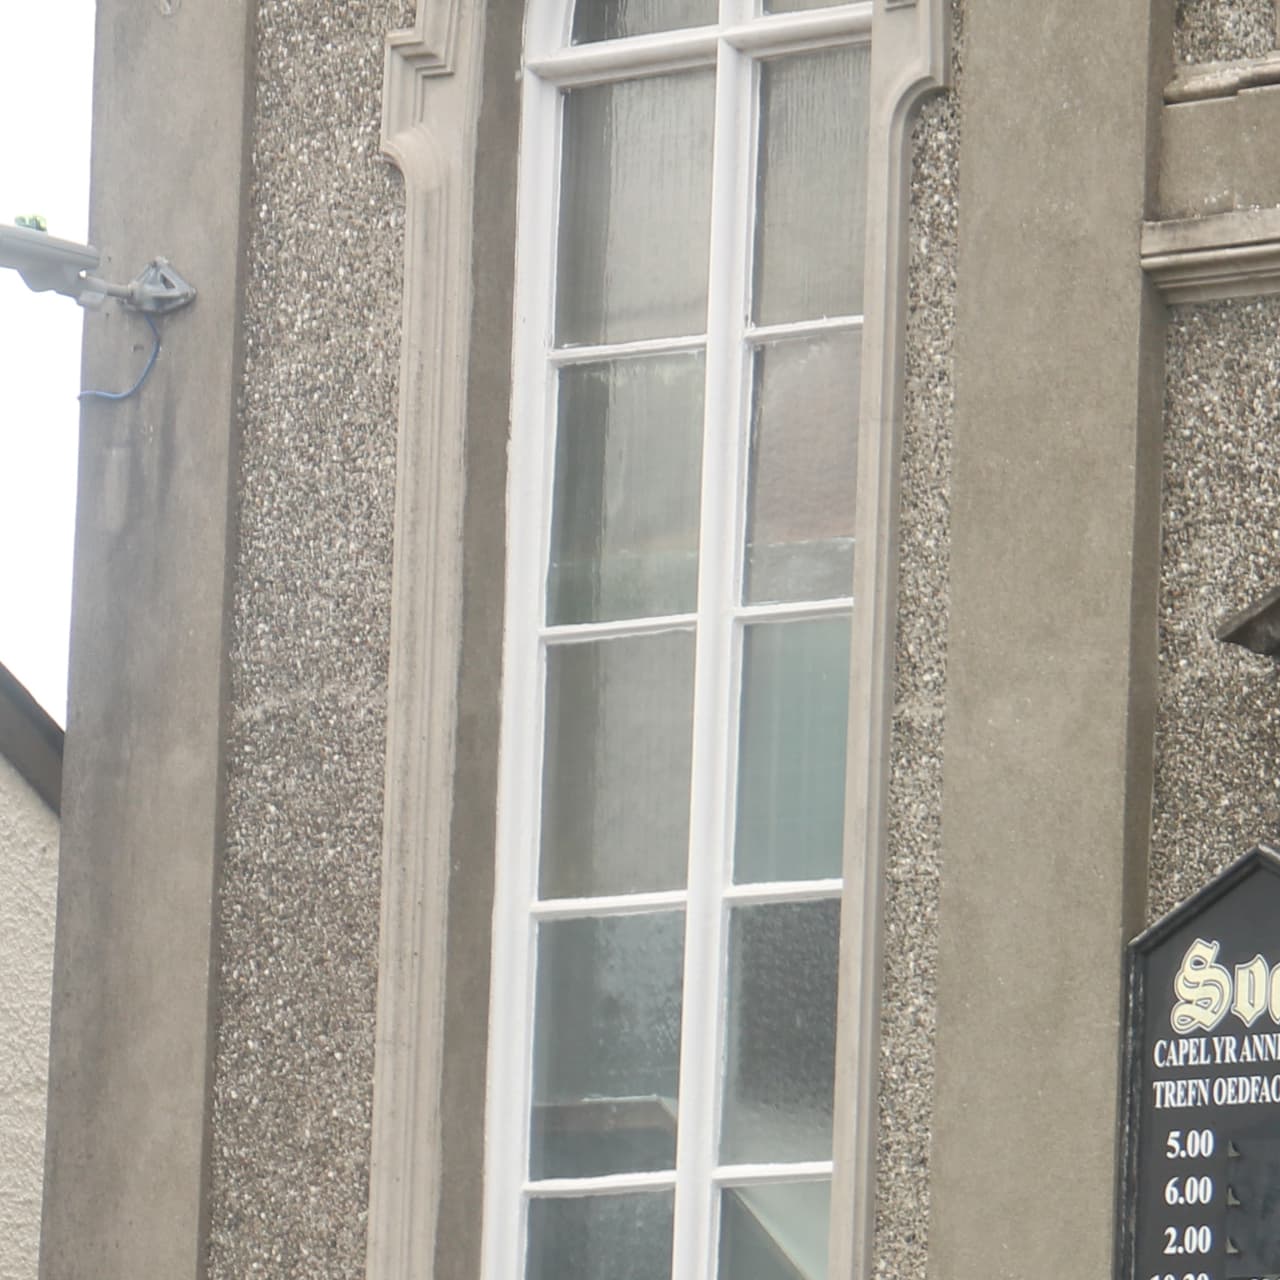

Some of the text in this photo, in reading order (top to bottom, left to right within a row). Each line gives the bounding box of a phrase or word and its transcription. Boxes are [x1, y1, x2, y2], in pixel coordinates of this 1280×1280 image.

[1154, 1036, 1210, 1067] CAPEL
[1213, 1034, 1237, 1064] YR
[1153, 1078, 1210, 1108] TREFN
[1166, 1129, 1213, 1159] 5.00
[1165, 1176, 1212, 1205] 6.00
[1163, 1225, 1211, 1254] 2.00
